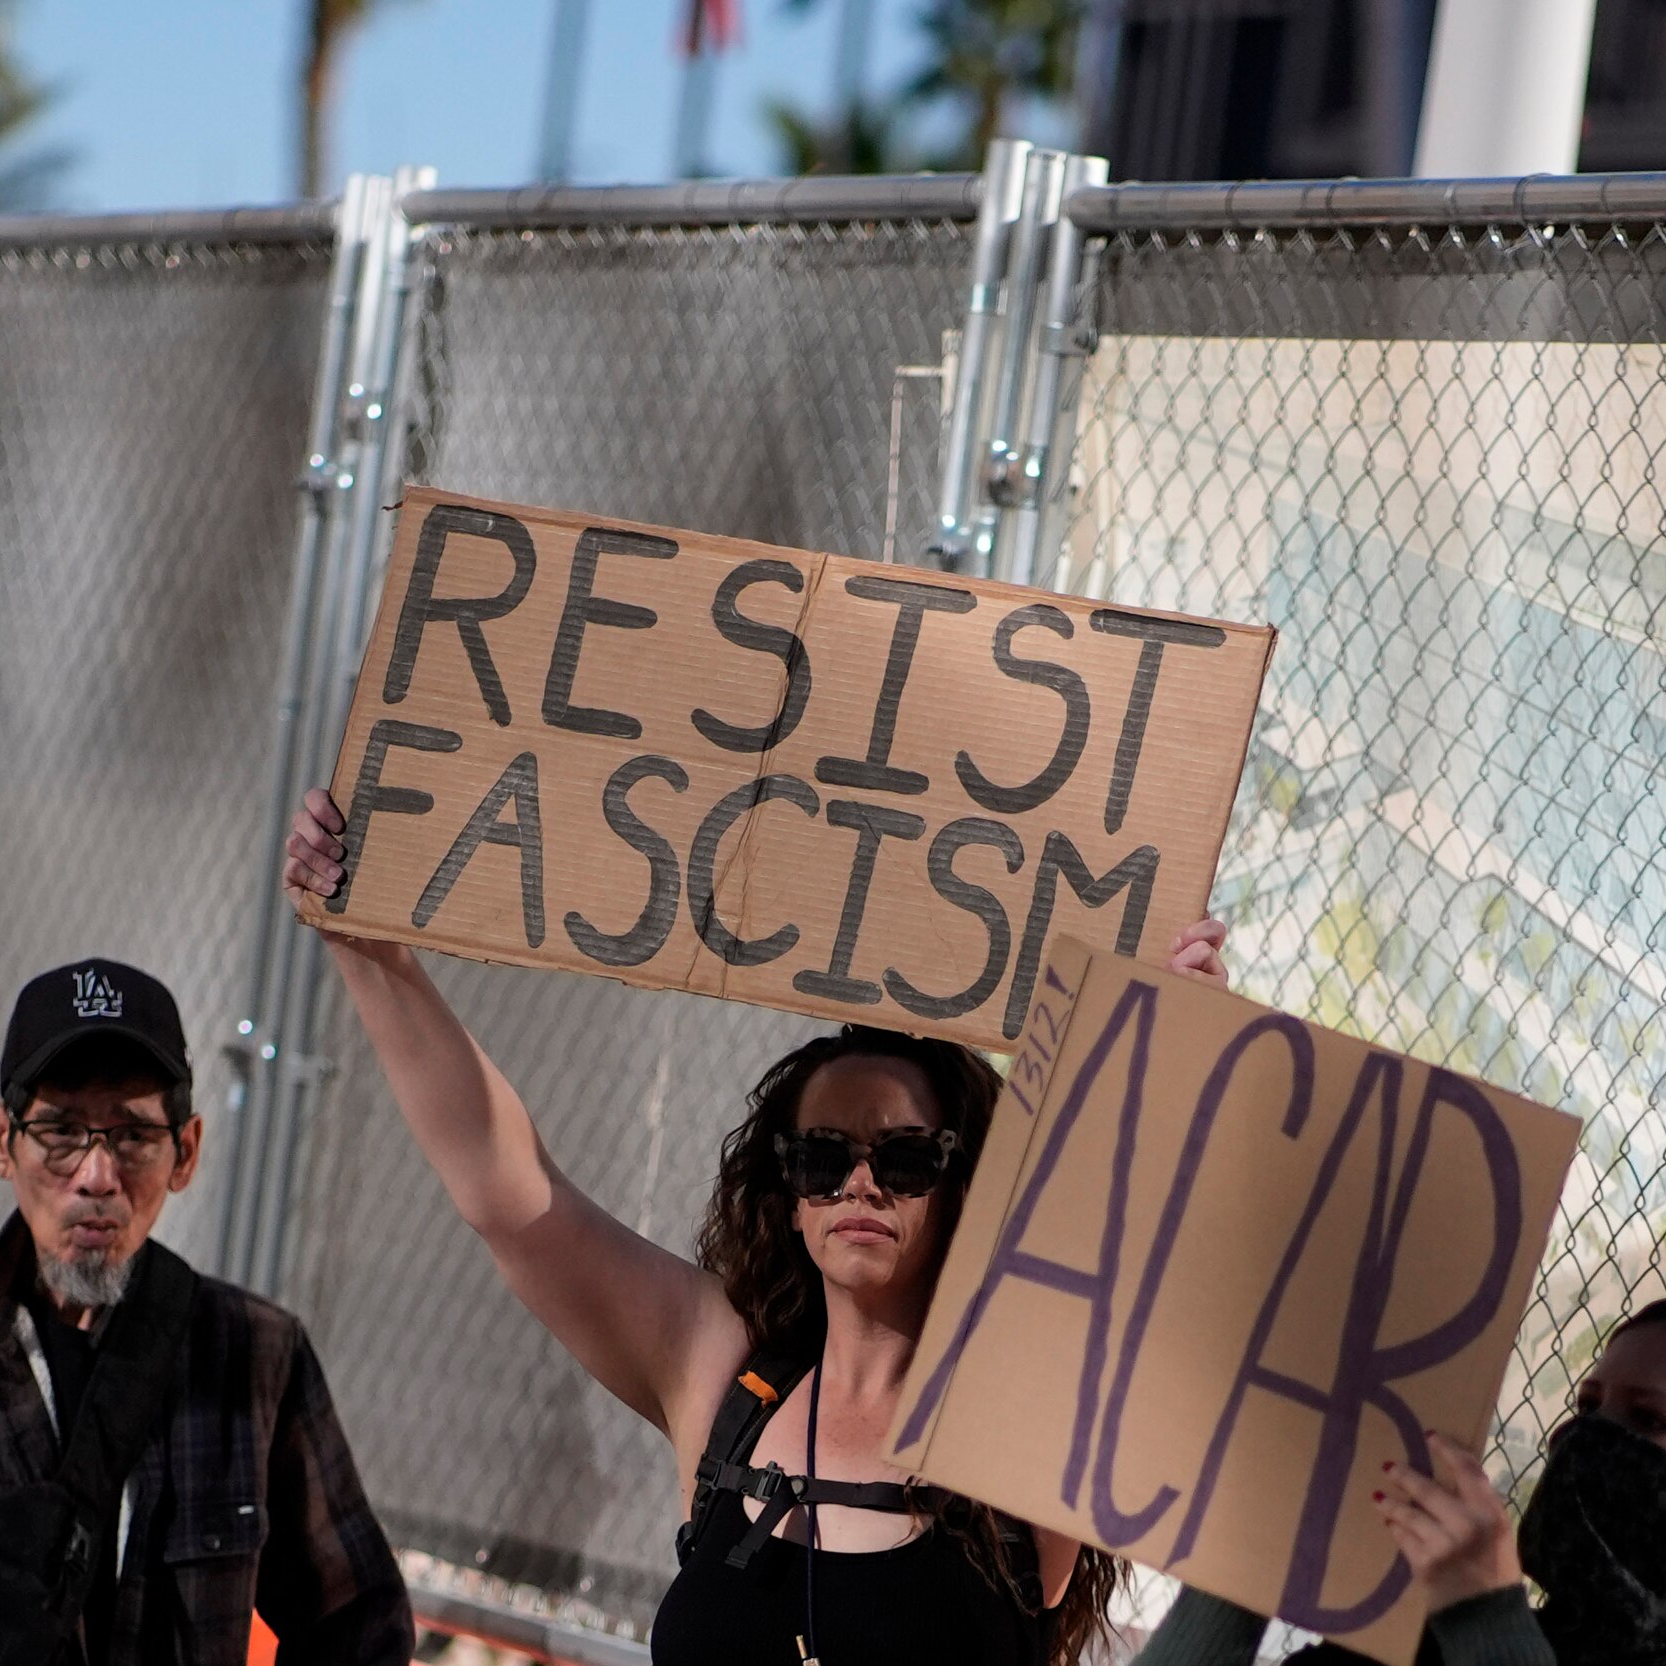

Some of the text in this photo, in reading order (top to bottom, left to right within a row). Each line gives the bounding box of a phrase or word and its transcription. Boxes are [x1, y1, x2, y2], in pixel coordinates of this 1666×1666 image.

[381, 503, 1226, 836] RESIST
[73, 967, 123, 1018] LA
[323, 717, 1161, 1041] FASCISM
[1009, 963, 1076, 1117] 1312!
[893, 978, 1523, 1635] ACAB
